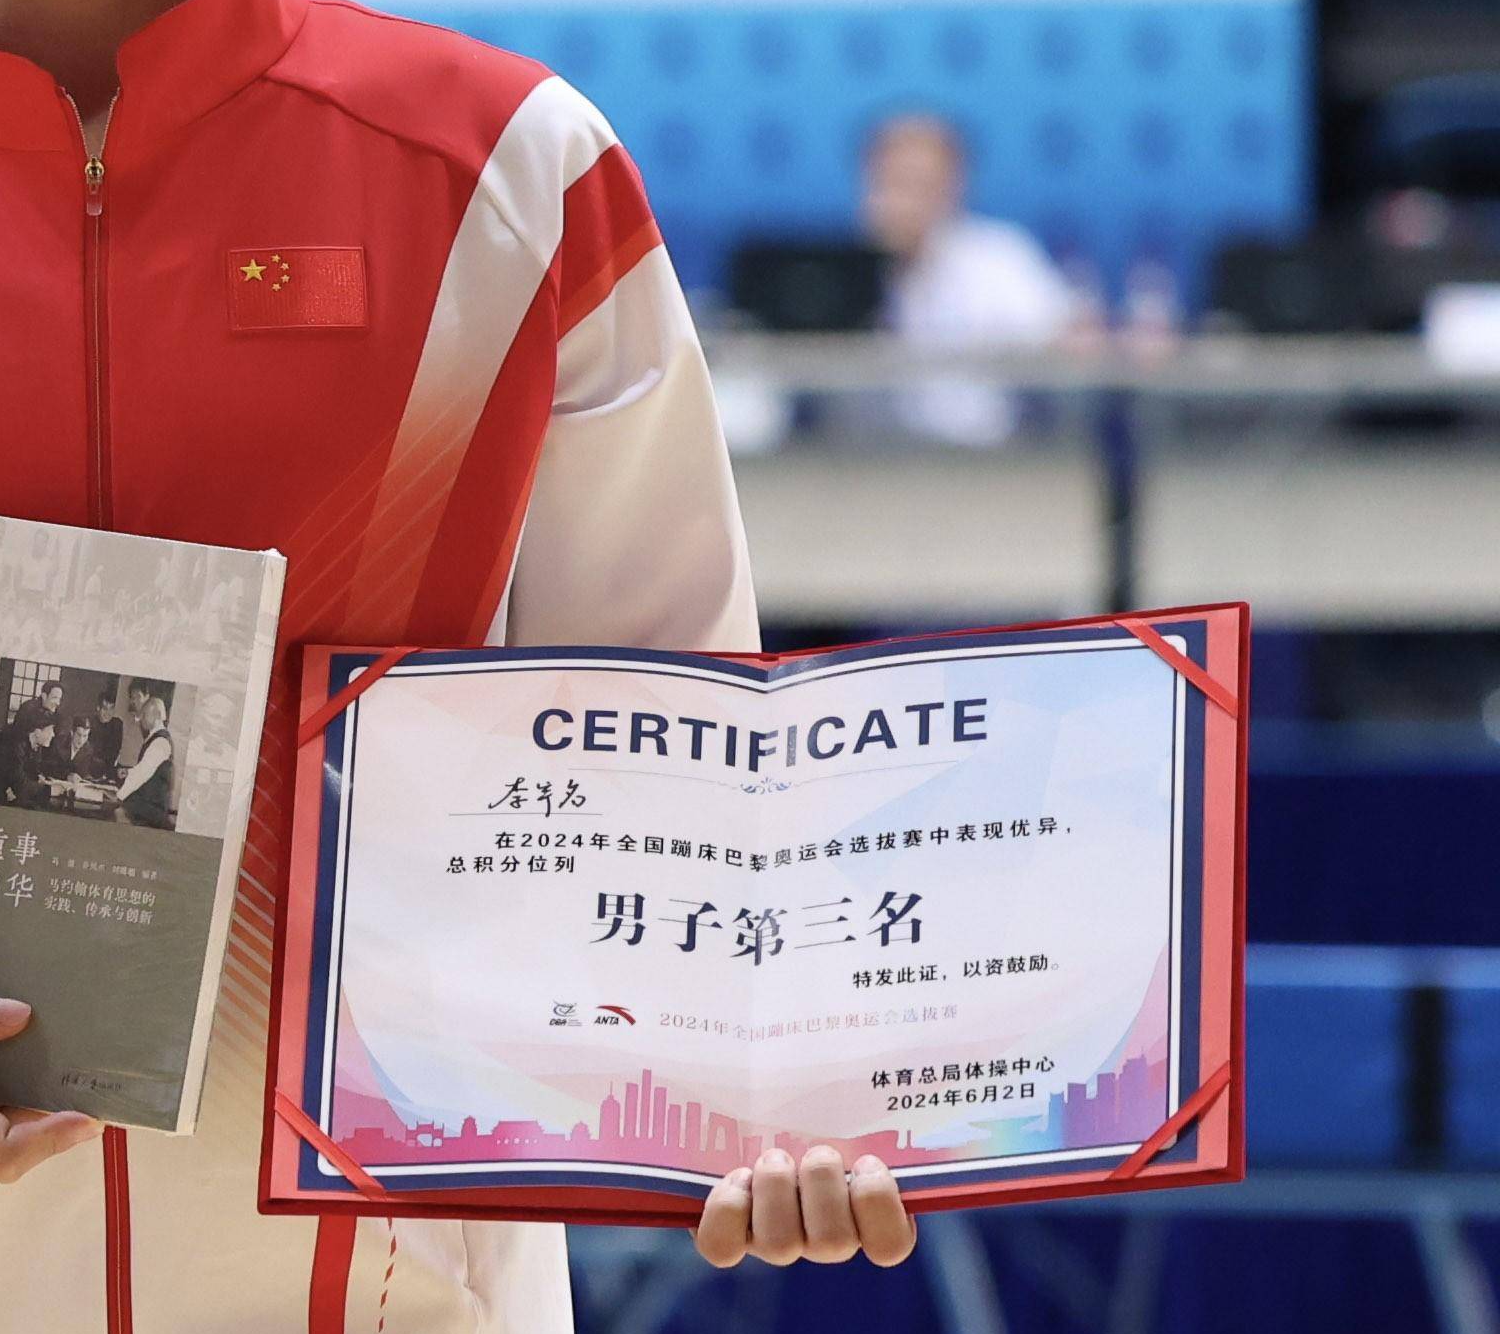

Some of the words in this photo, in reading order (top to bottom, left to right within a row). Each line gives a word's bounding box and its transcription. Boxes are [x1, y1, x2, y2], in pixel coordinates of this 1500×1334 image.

[533, 698, 987, 773] CERTIFICATE
[446, 856, 575, 874] 总积分位列
[590, 890, 924, 966] 男子第三名
[595, 1015, 619, 1025] ANTA
[871, 1056, 1055, 1089] 体育总局体操中心
[887, 1082, 1036, 1112] 2024年6月2日
